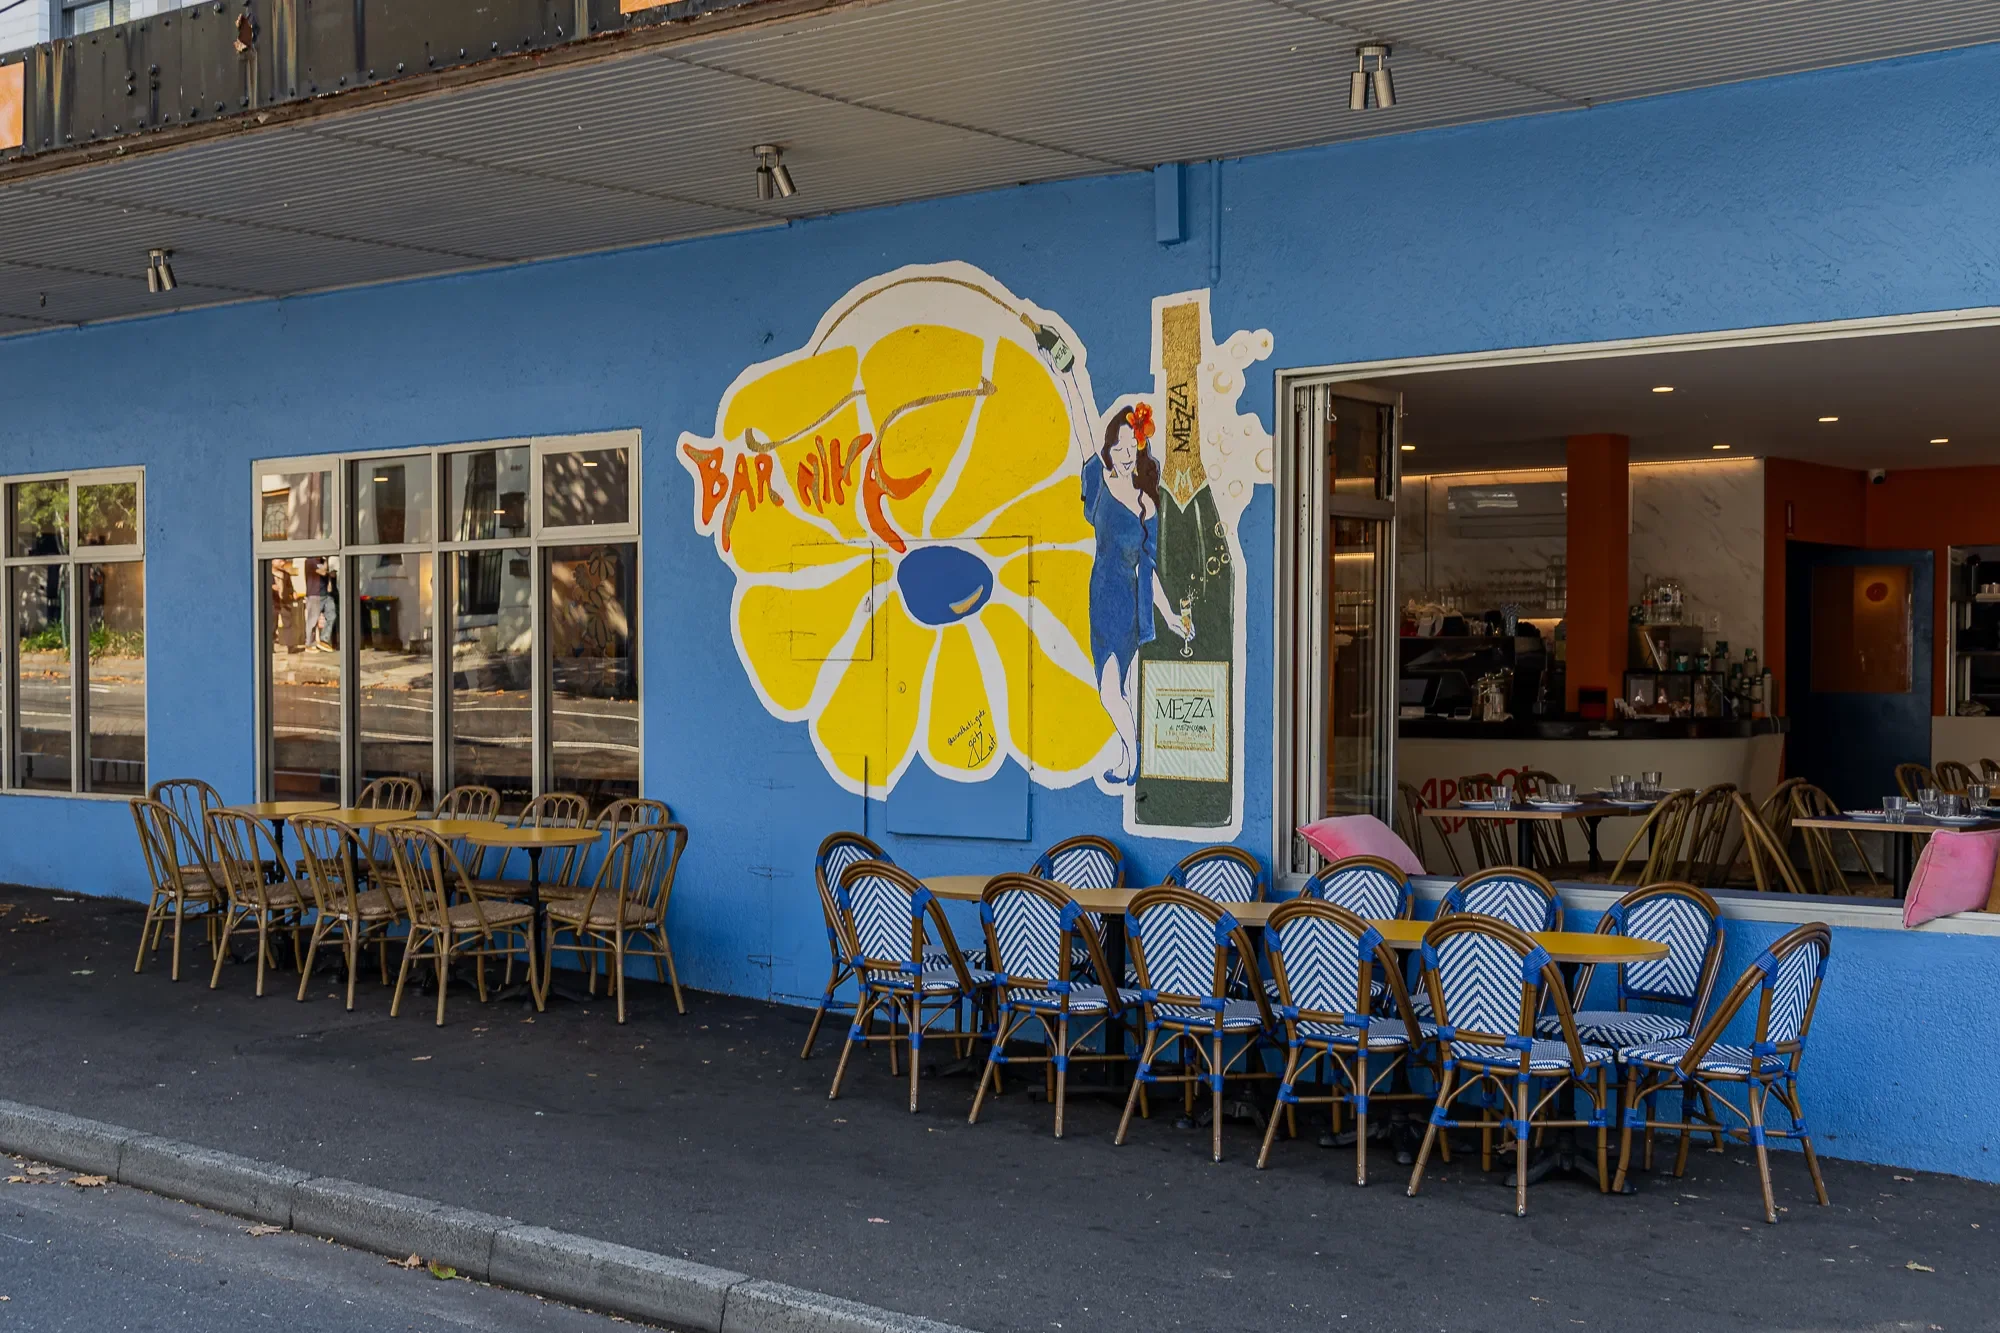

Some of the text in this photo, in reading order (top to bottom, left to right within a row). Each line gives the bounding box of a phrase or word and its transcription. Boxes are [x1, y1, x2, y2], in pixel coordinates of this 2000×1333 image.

[1169, 381, 1195, 453] MEZZA
[683, 443, 784, 553] BAR
[1155, 697, 1214, 723] MEZZA
